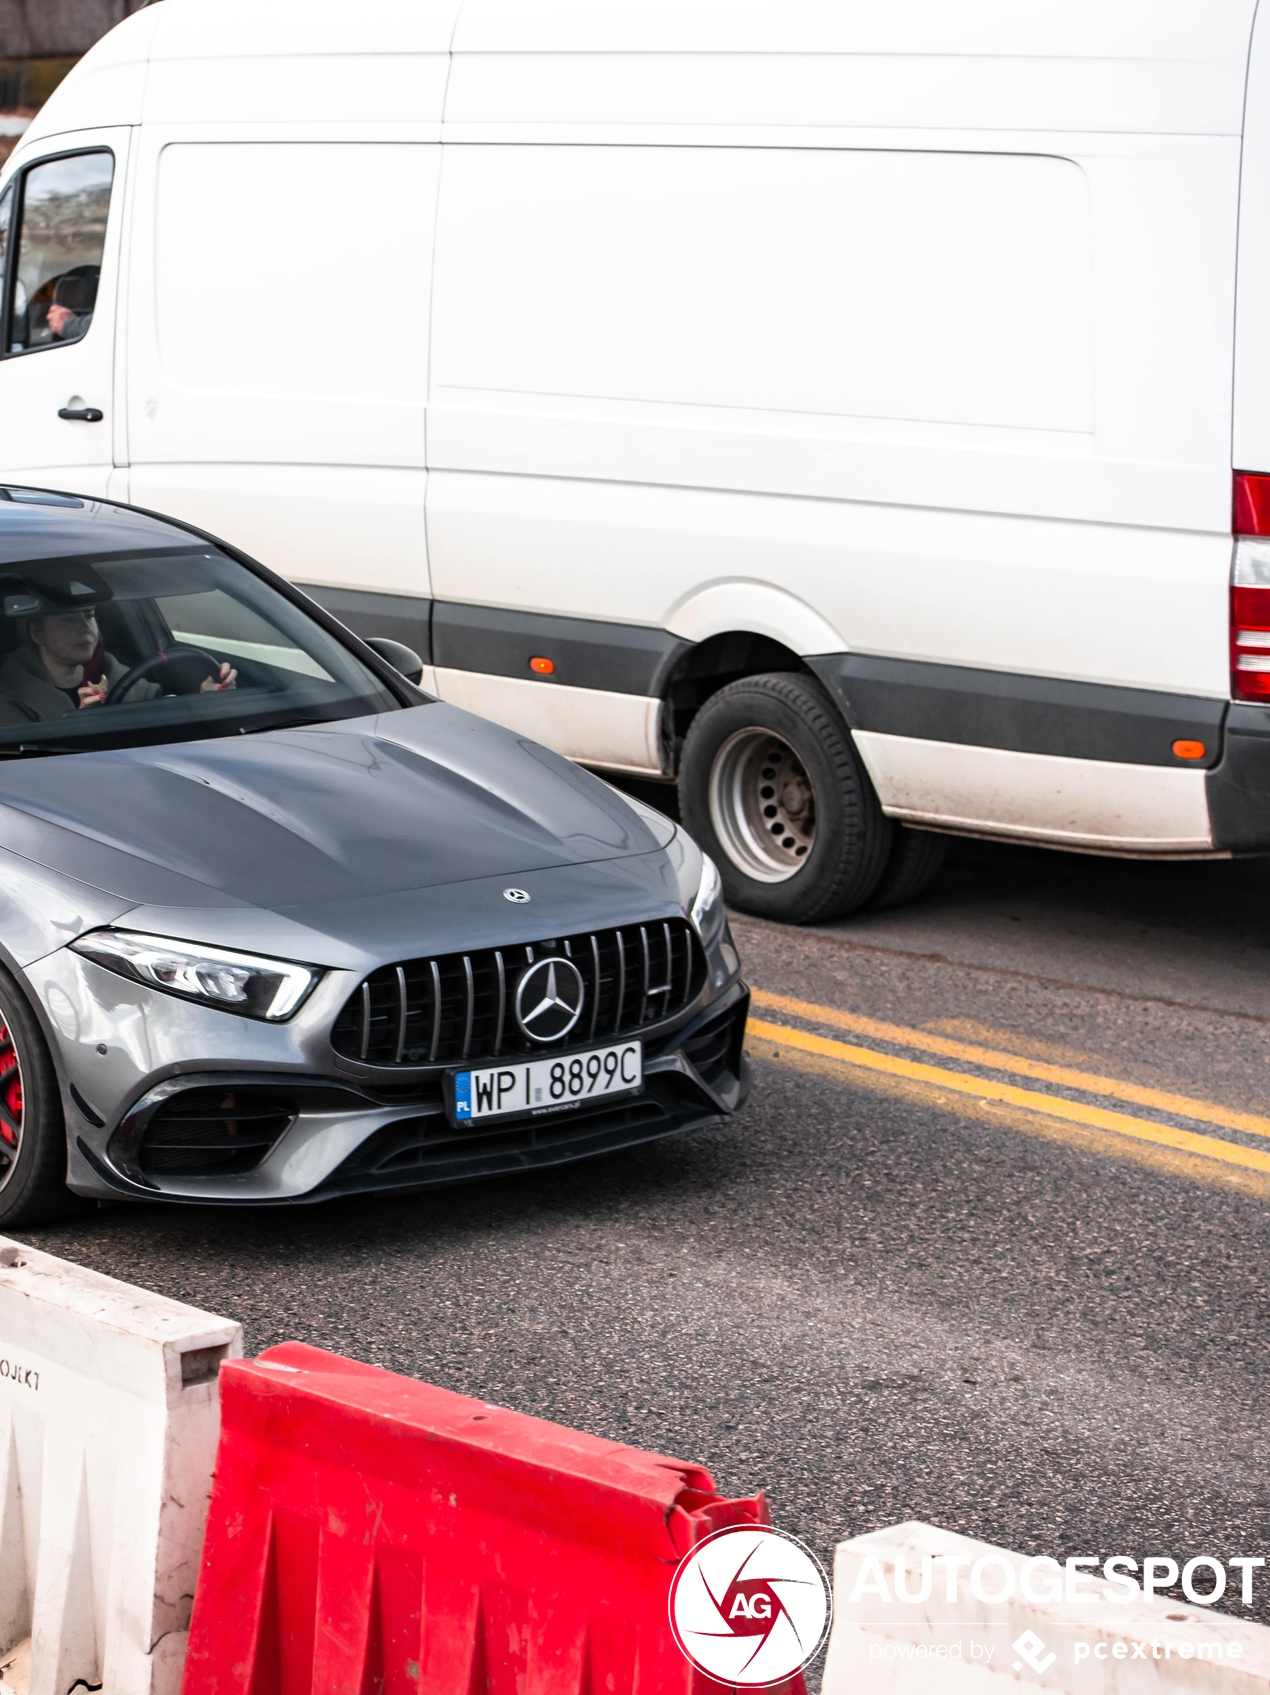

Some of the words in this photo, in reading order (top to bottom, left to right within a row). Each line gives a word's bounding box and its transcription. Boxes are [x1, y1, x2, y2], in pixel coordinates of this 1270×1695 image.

[475, 1067, 530, 1113] WPI
[549, 1047, 636, 1100] 8899C
[456, 1101, 470, 1112] PL
